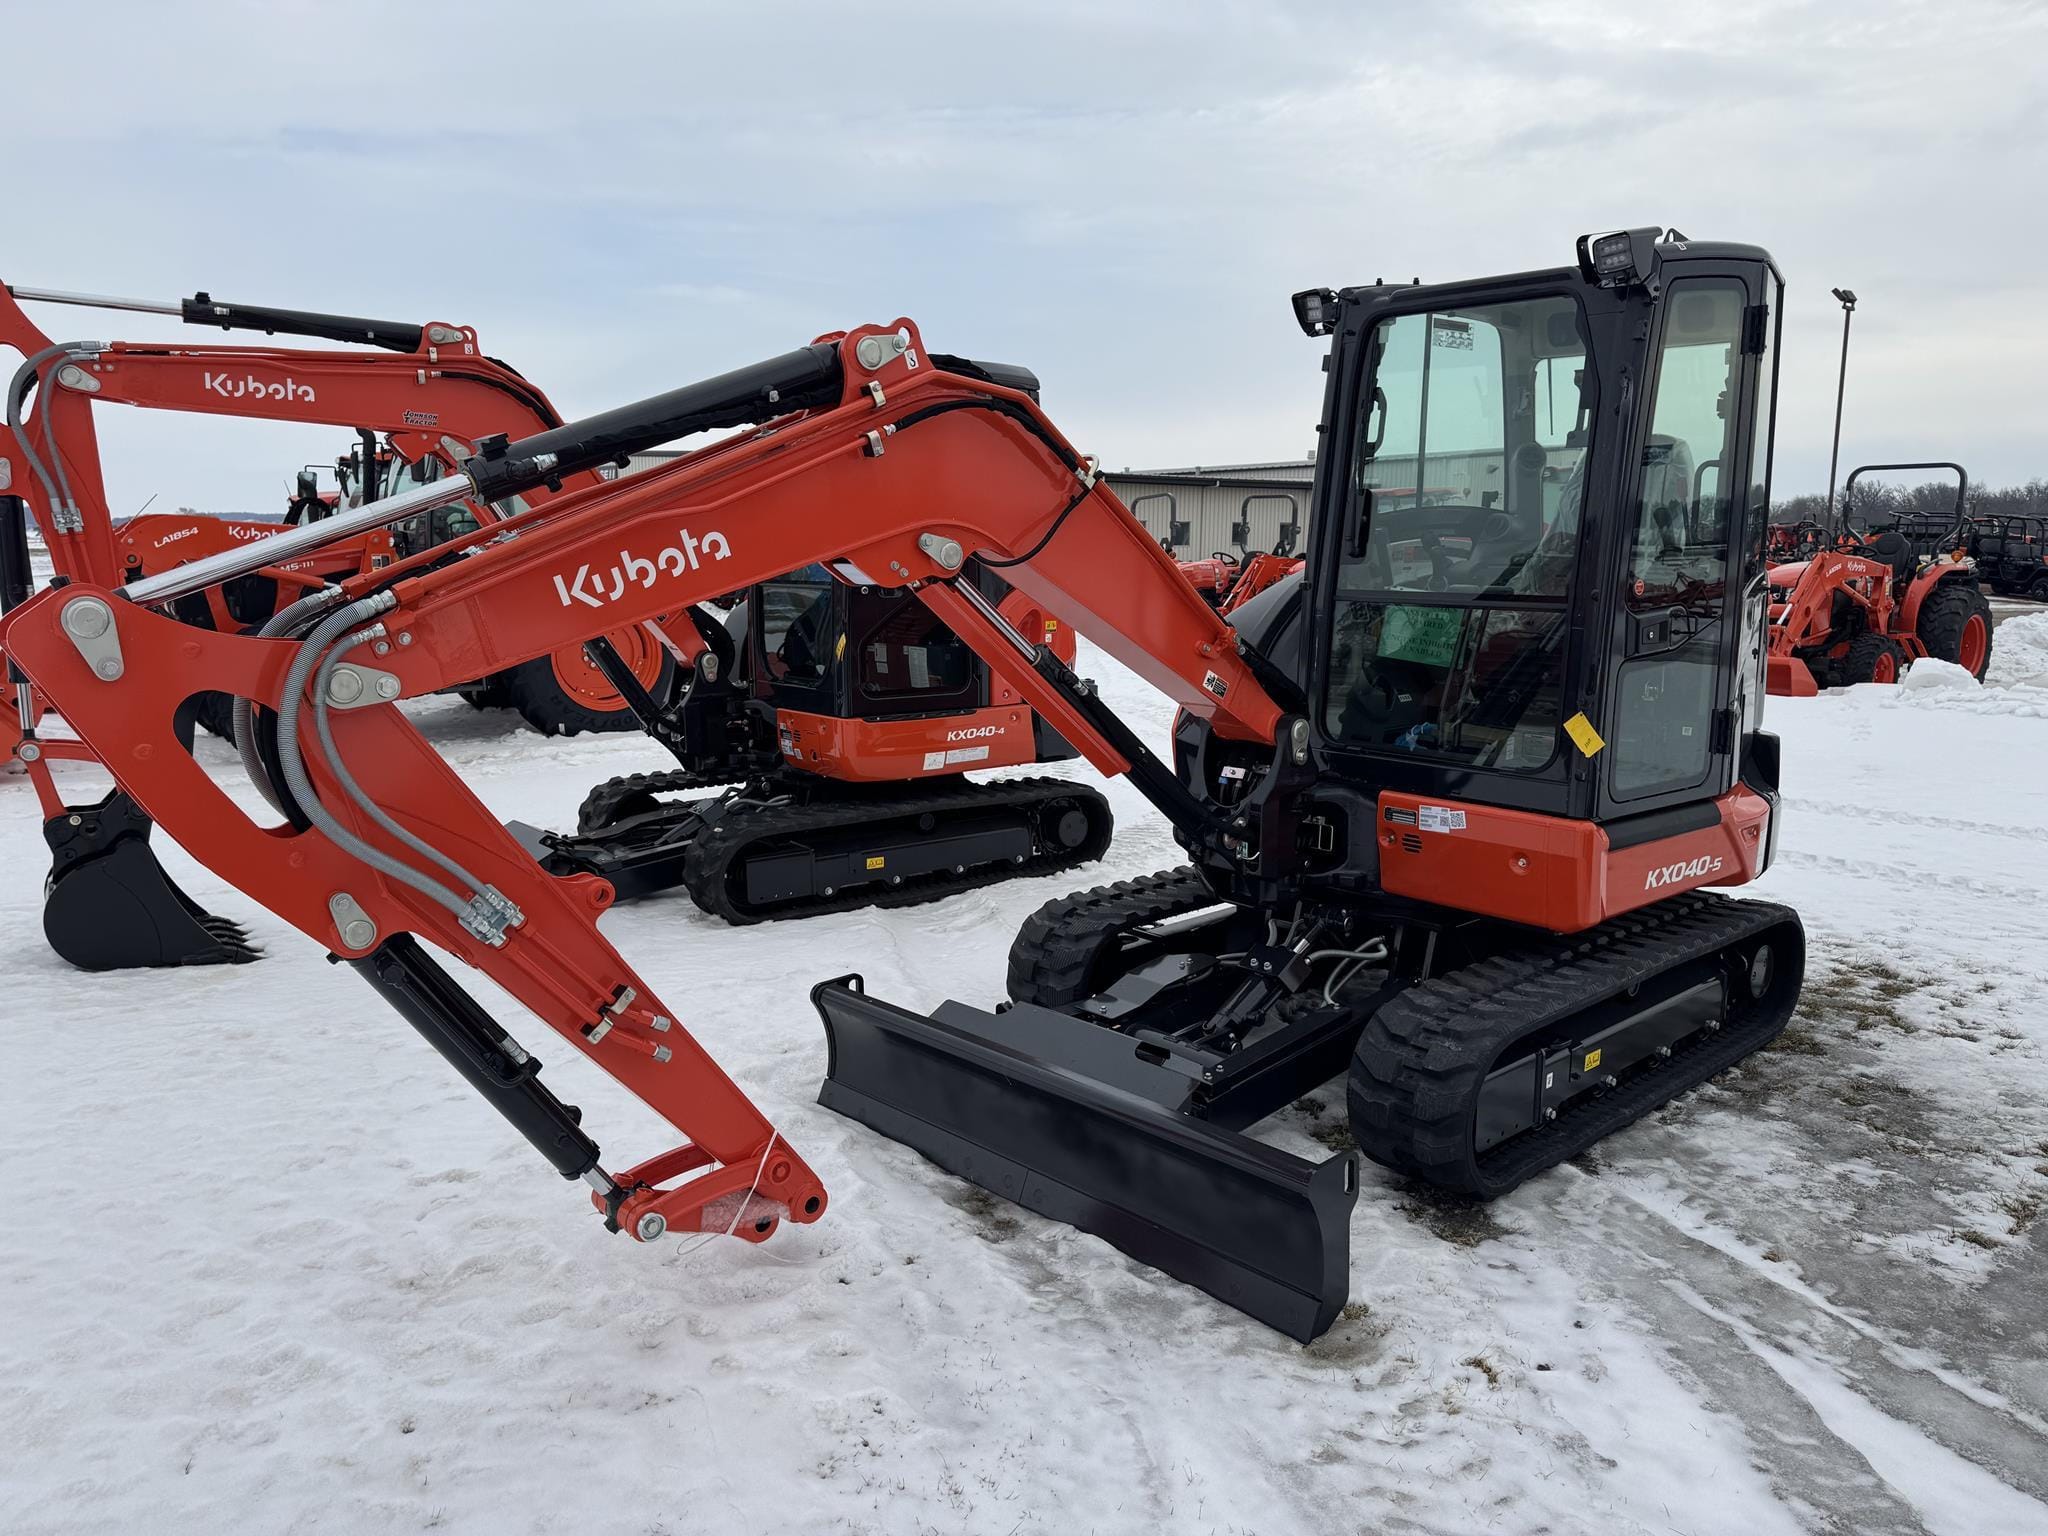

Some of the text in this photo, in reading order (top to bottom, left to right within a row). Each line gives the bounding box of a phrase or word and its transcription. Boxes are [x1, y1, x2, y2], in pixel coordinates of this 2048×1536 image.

[204, 372, 316, 402] Kubota
[403, 410, 438, 420] JOHNSON
[404, 416, 438, 426] TRACTOR
[154, 526, 199, 549] LA1854
[228, 525, 282, 541] Kubot
[552, 528, 732, 608] Kubota
[947, 726, 1005, 742] KX040-4
[1644, 855, 1723, 890] KX040-5
